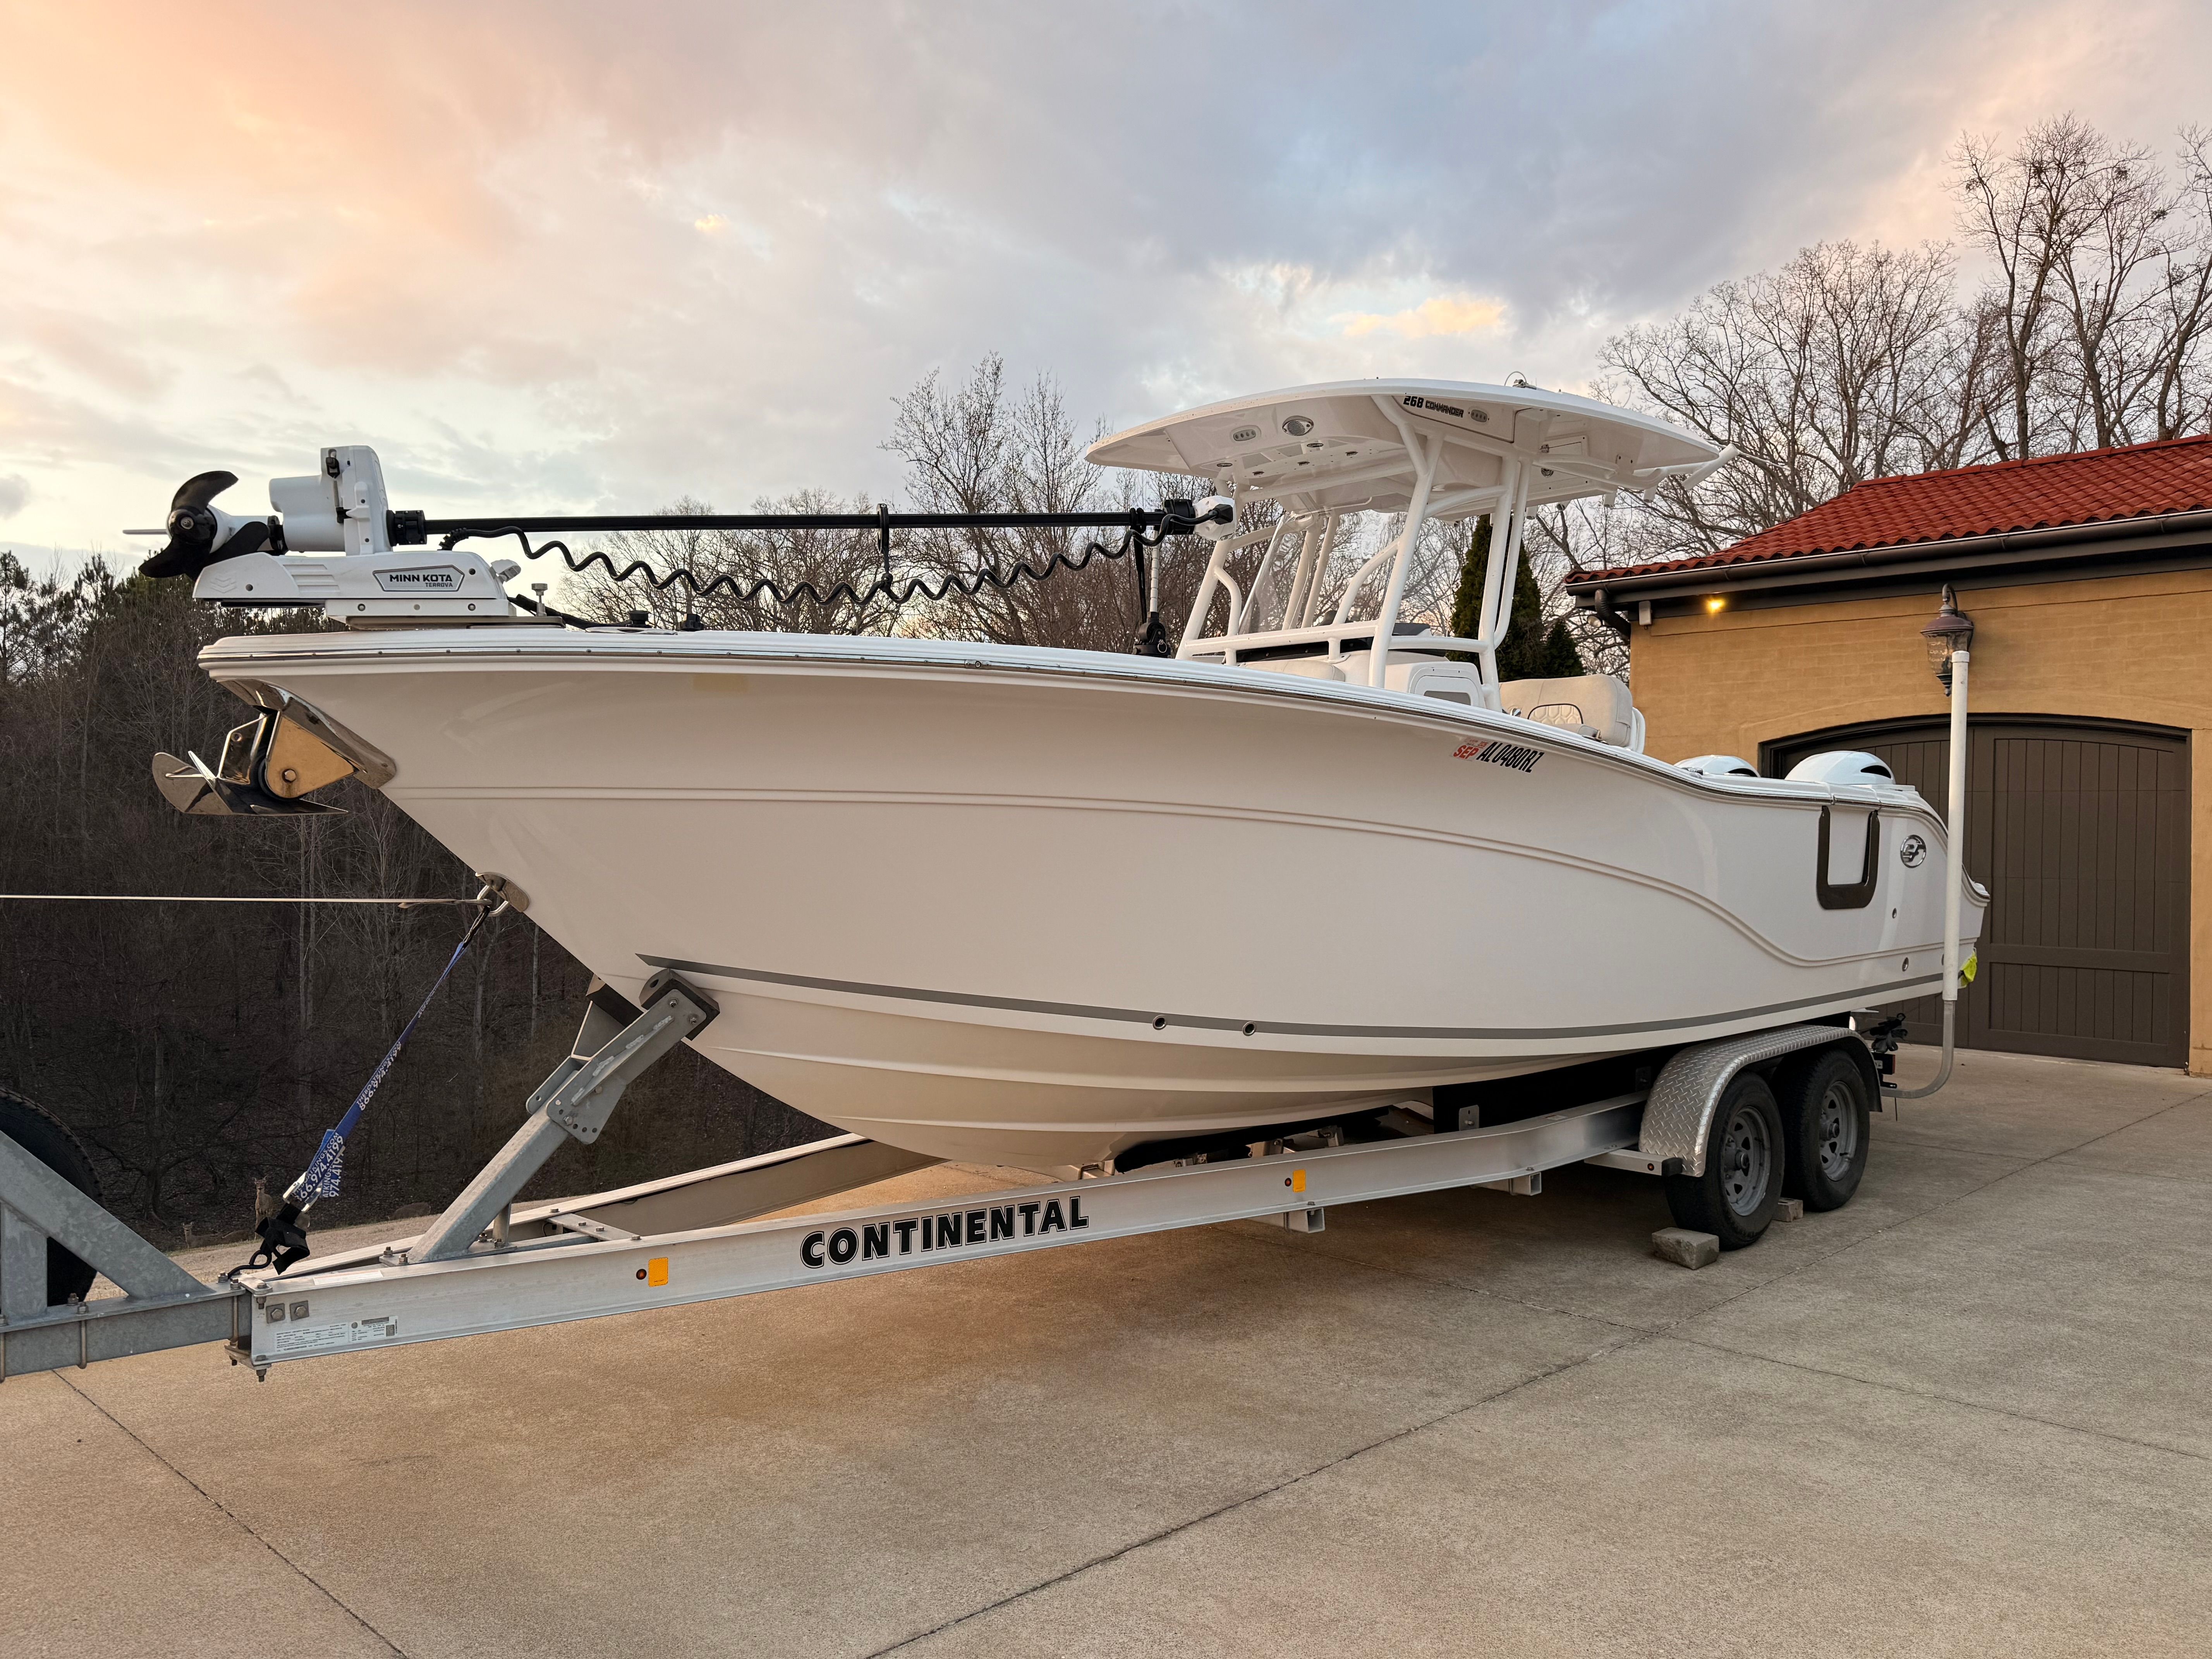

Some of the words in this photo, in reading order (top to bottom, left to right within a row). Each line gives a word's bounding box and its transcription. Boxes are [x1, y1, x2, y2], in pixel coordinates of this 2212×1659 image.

[1403, 396, 1424, 408] 268
[1425, 400, 1464, 418] COMMANDER
[1453, 745, 1479, 759] SEP
[800, 1195, 1089, 1269] CONTINENTAL
